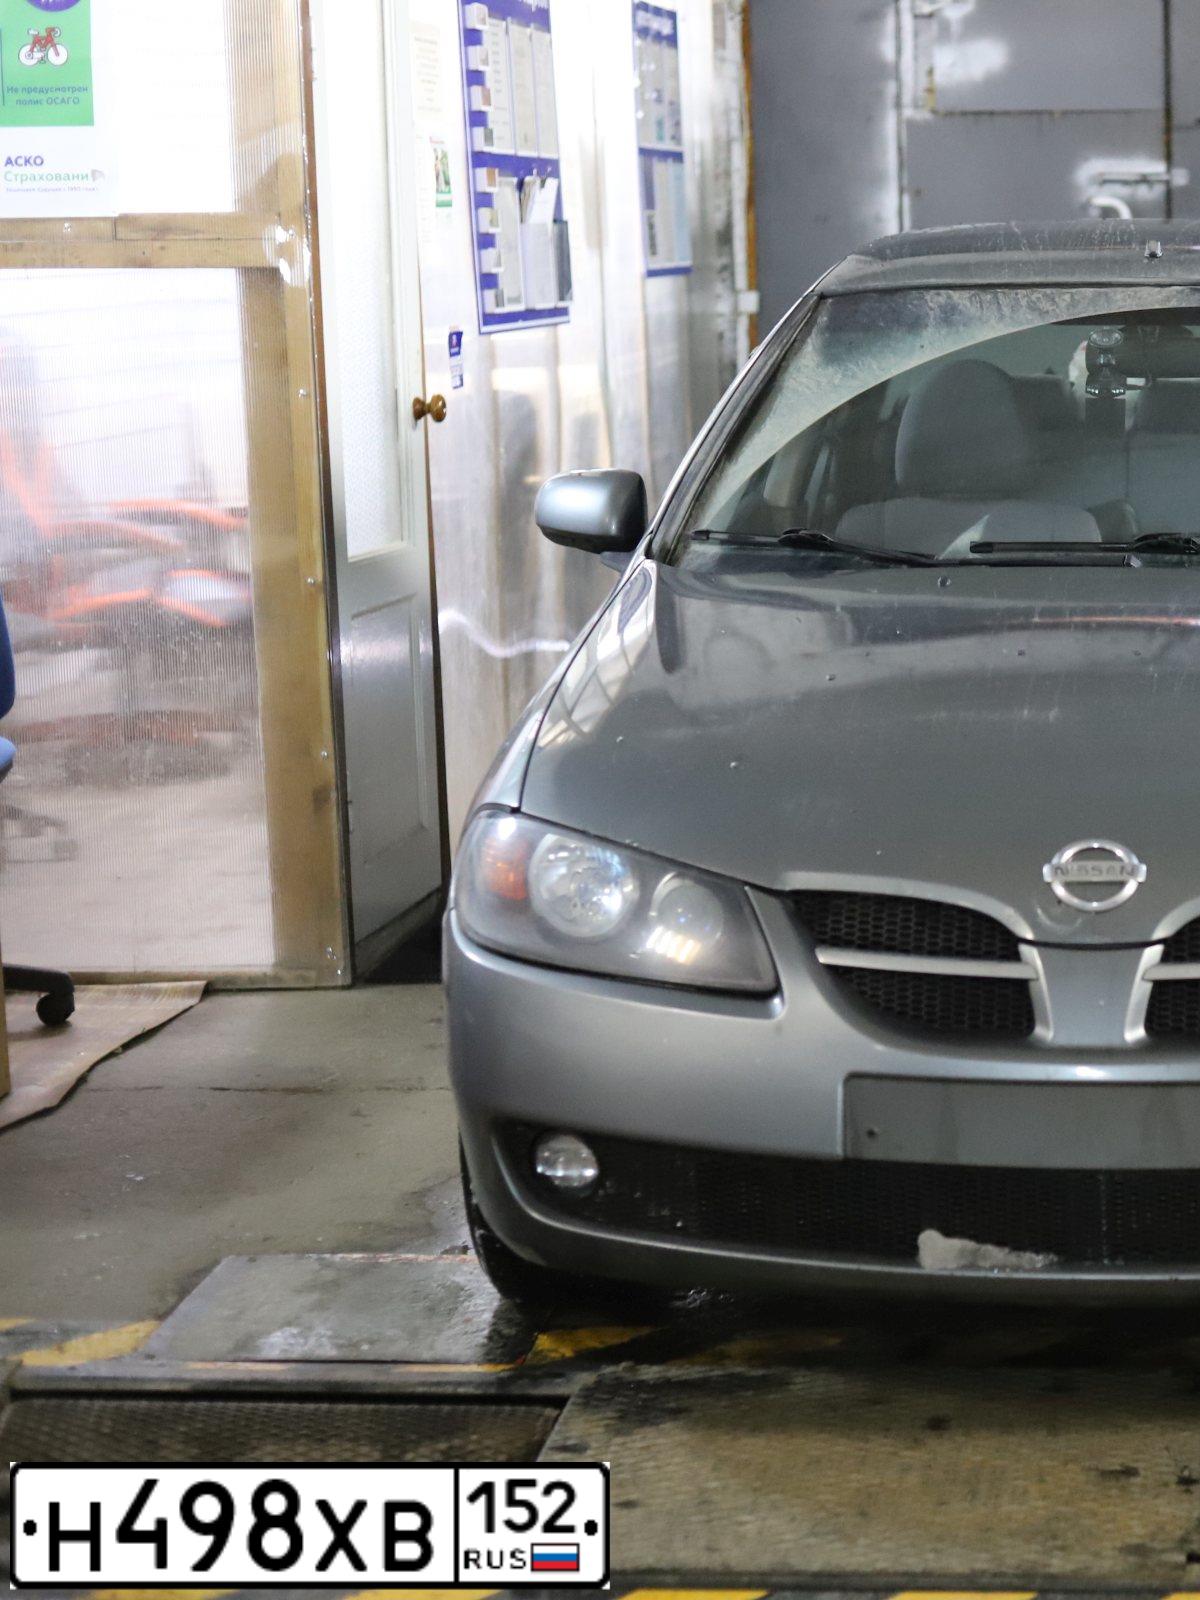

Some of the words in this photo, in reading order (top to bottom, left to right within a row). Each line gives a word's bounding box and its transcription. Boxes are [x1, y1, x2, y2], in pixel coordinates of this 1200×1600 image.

[6, 86, 19, 94] Не
[46, 97, 80, 105] ОСАГО
[4, 155, 44, 168] АСКО
[4, 170, 95, 184] Страховани
[1053, 864, 1139, 877] NISSAN
